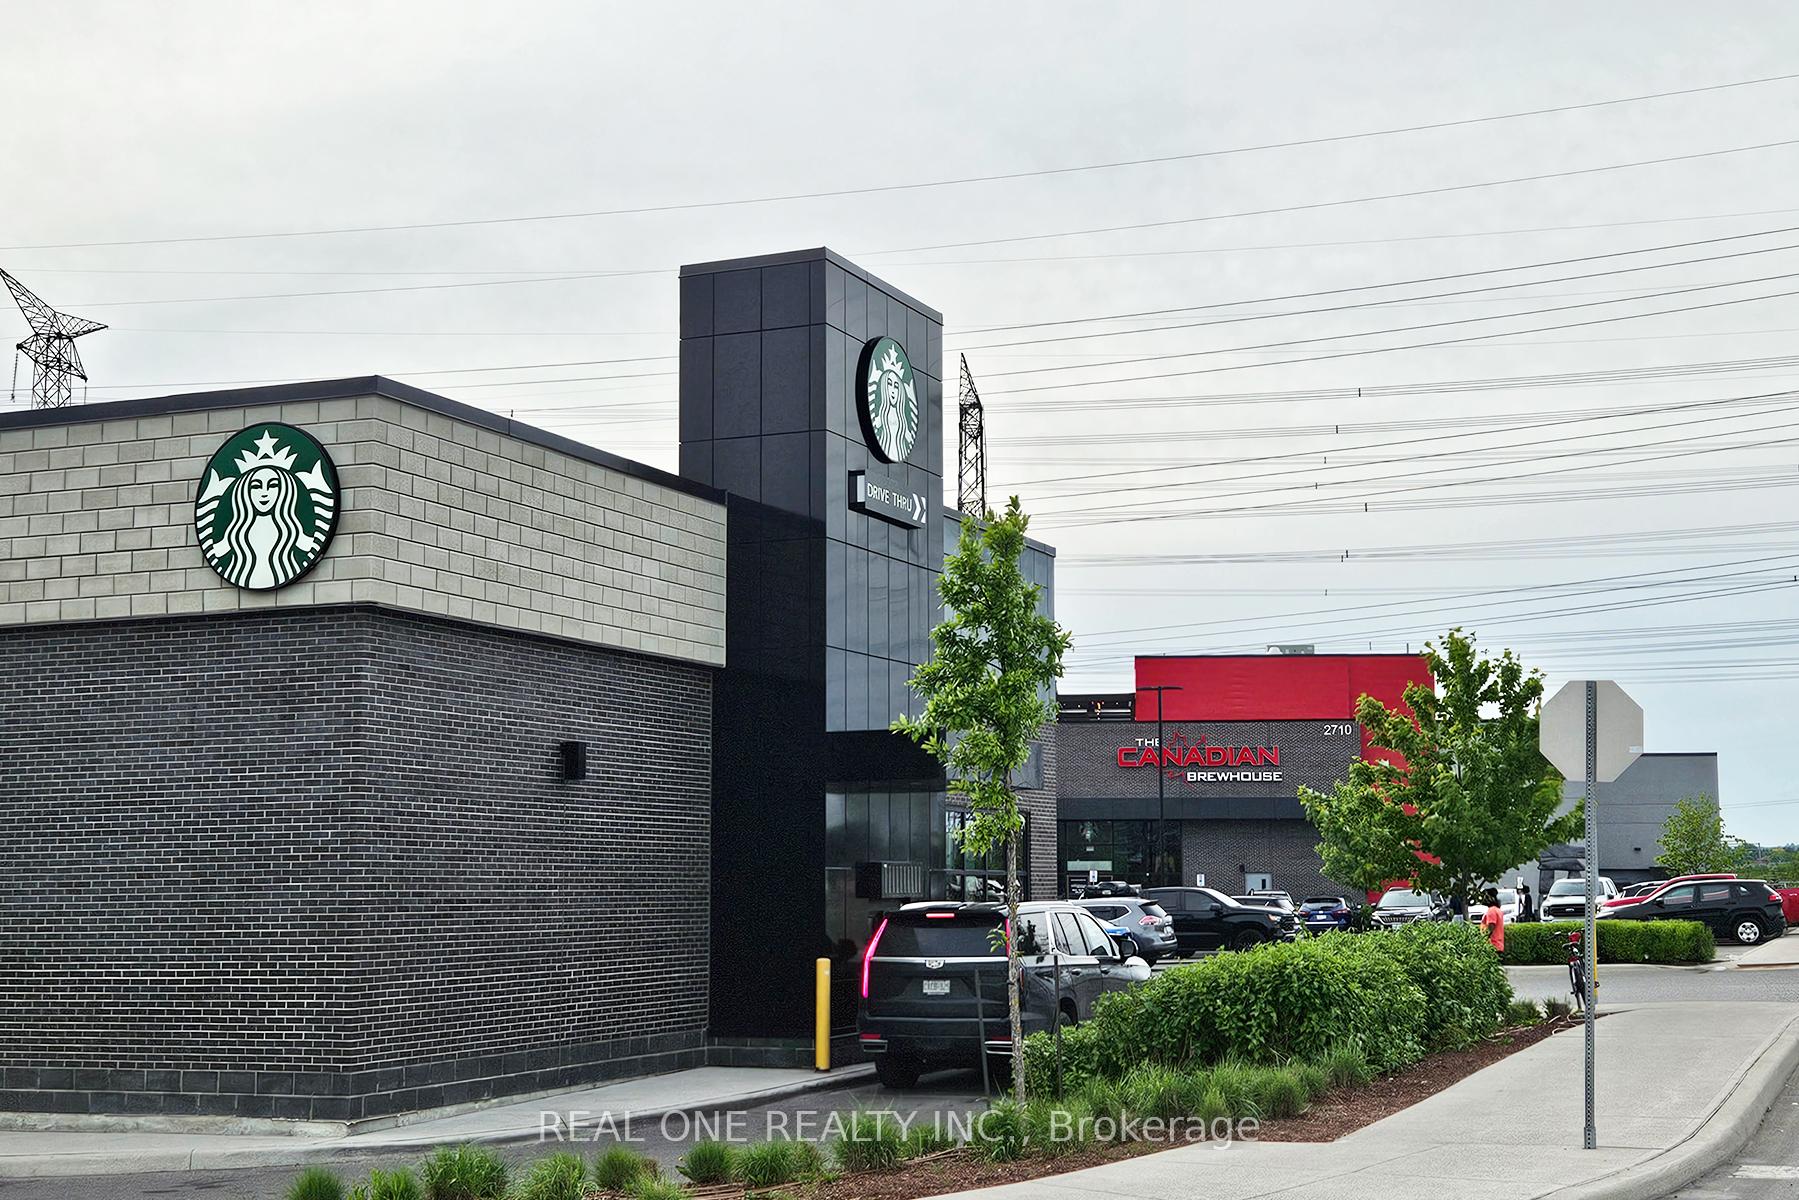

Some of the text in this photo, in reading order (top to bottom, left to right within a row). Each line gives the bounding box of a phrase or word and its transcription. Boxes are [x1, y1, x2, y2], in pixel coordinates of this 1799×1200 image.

[867, 482, 913, 512] DRIVE THRU
[1323, 724, 1352, 736] 2710
[1135, 738, 1160, 747] THE
[1117, 745, 1279, 767] CANADIAN
[1186, 771, 1283, 782] BREWHOUSE
